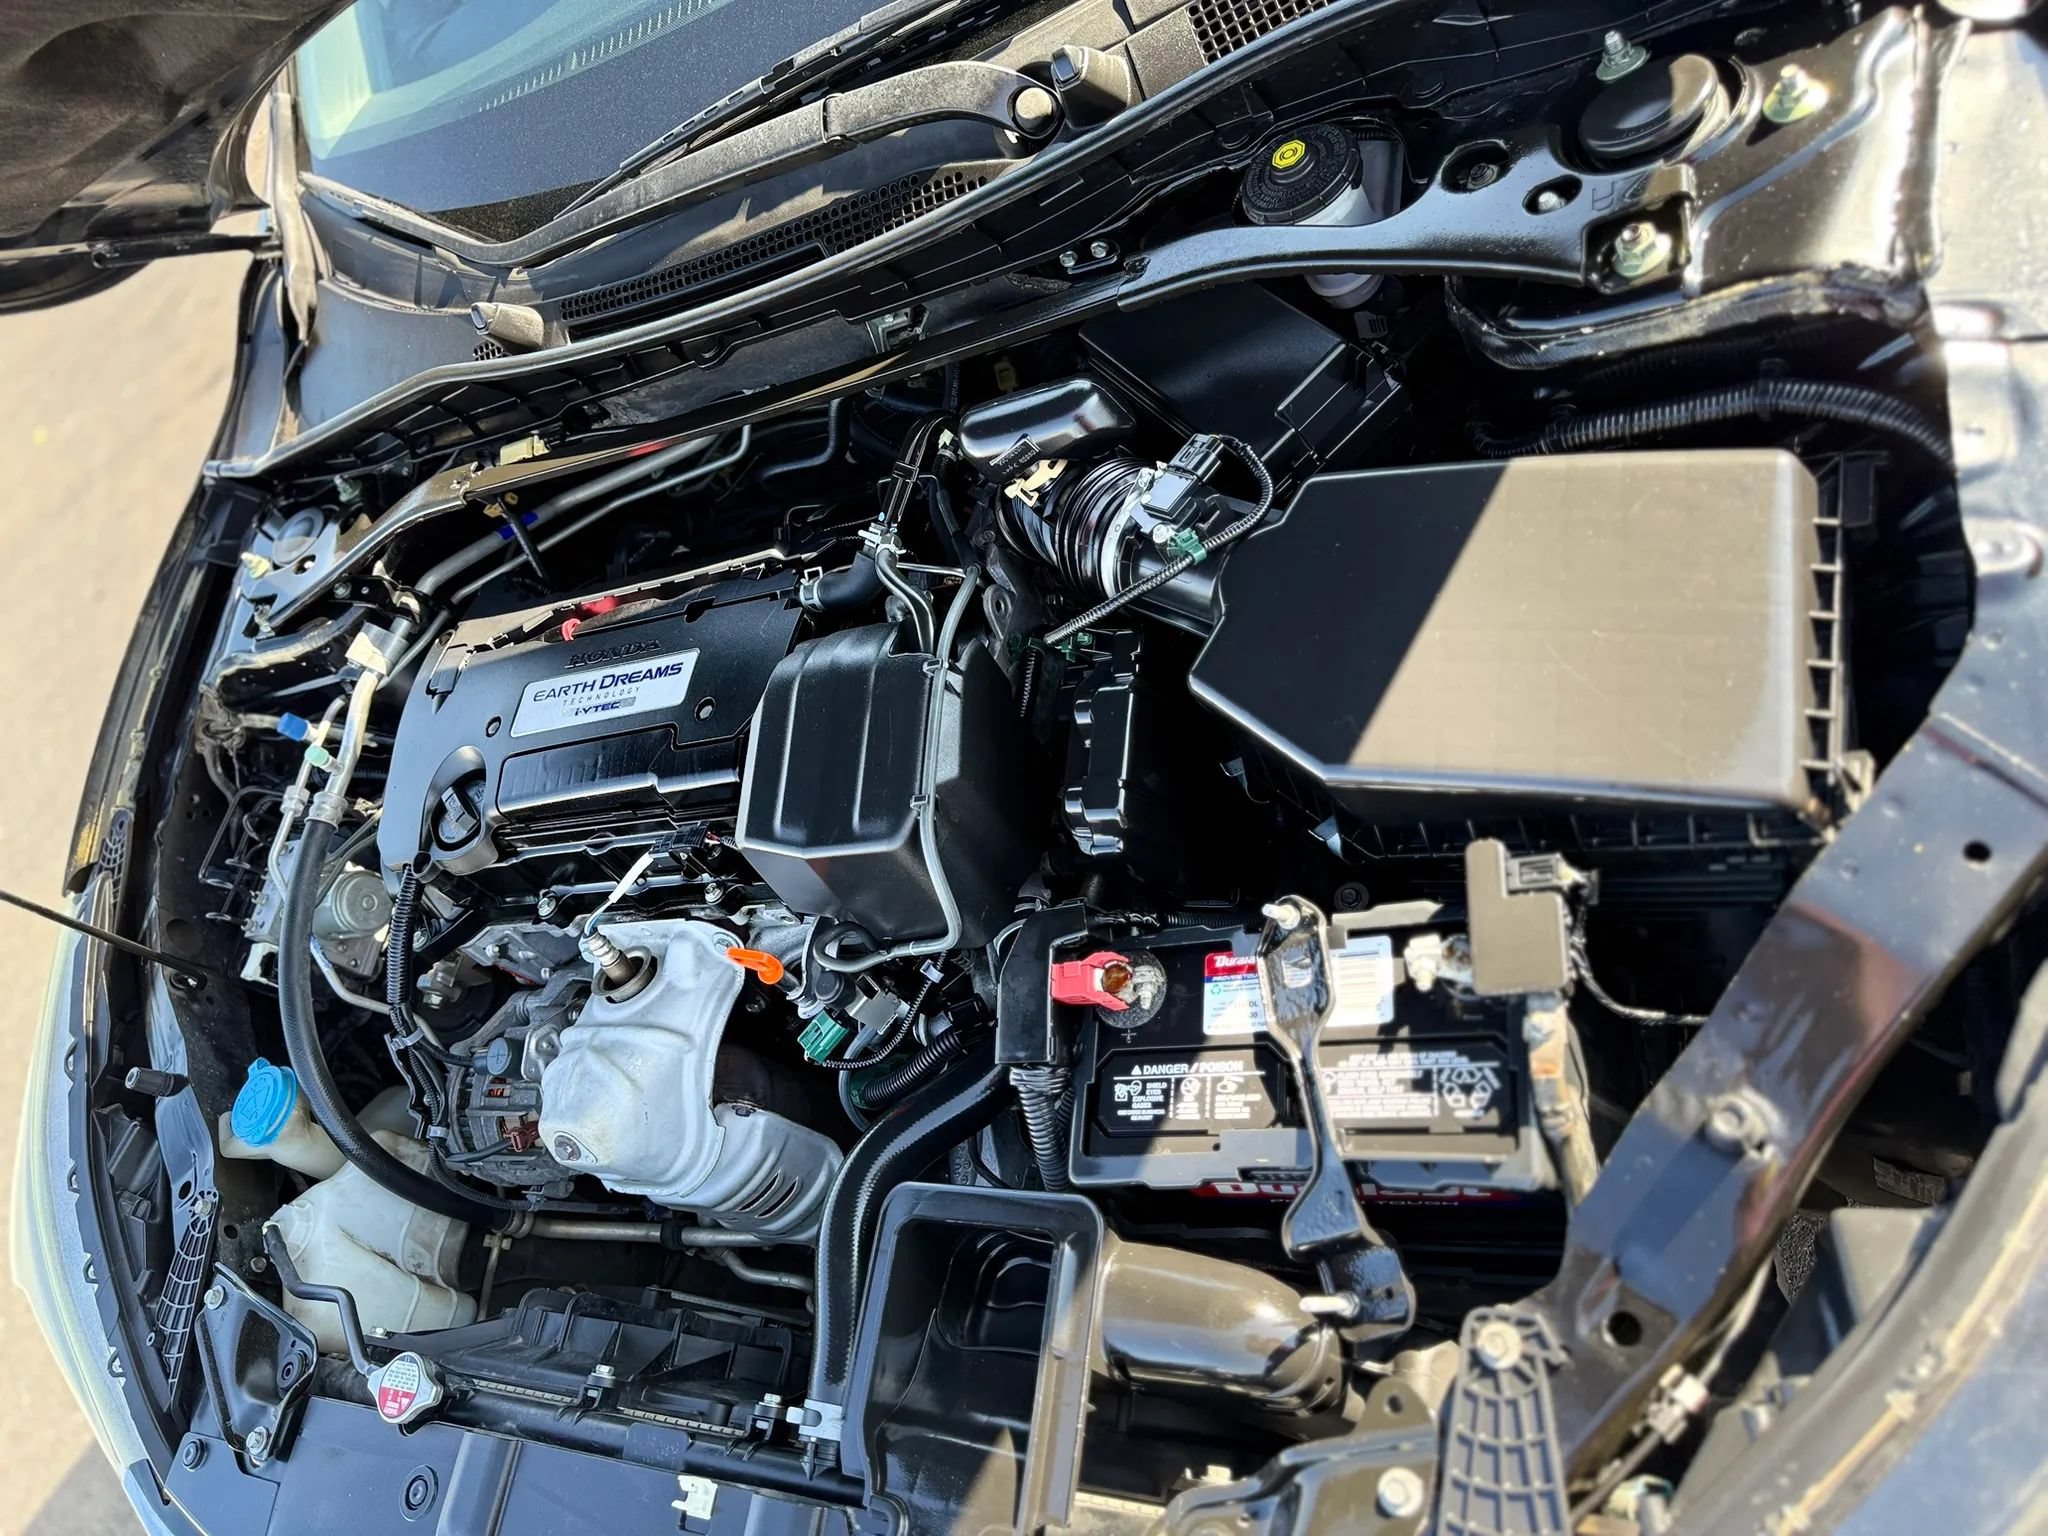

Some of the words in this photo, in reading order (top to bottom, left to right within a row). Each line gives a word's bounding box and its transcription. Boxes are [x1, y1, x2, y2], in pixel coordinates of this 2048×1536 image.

[565, 640, 661, 669] HONDA
[533, 679, 597, 702] EARTH
[599, 662, 684, 689] DREAMS
[563, 686, 641, 707] TECHNOLOGY
[1213, 955, 1256, 968] Durala
[1143, 1063, 1189, 1075] DANGER
[1199, 1060, 1244, 1073] POISON
